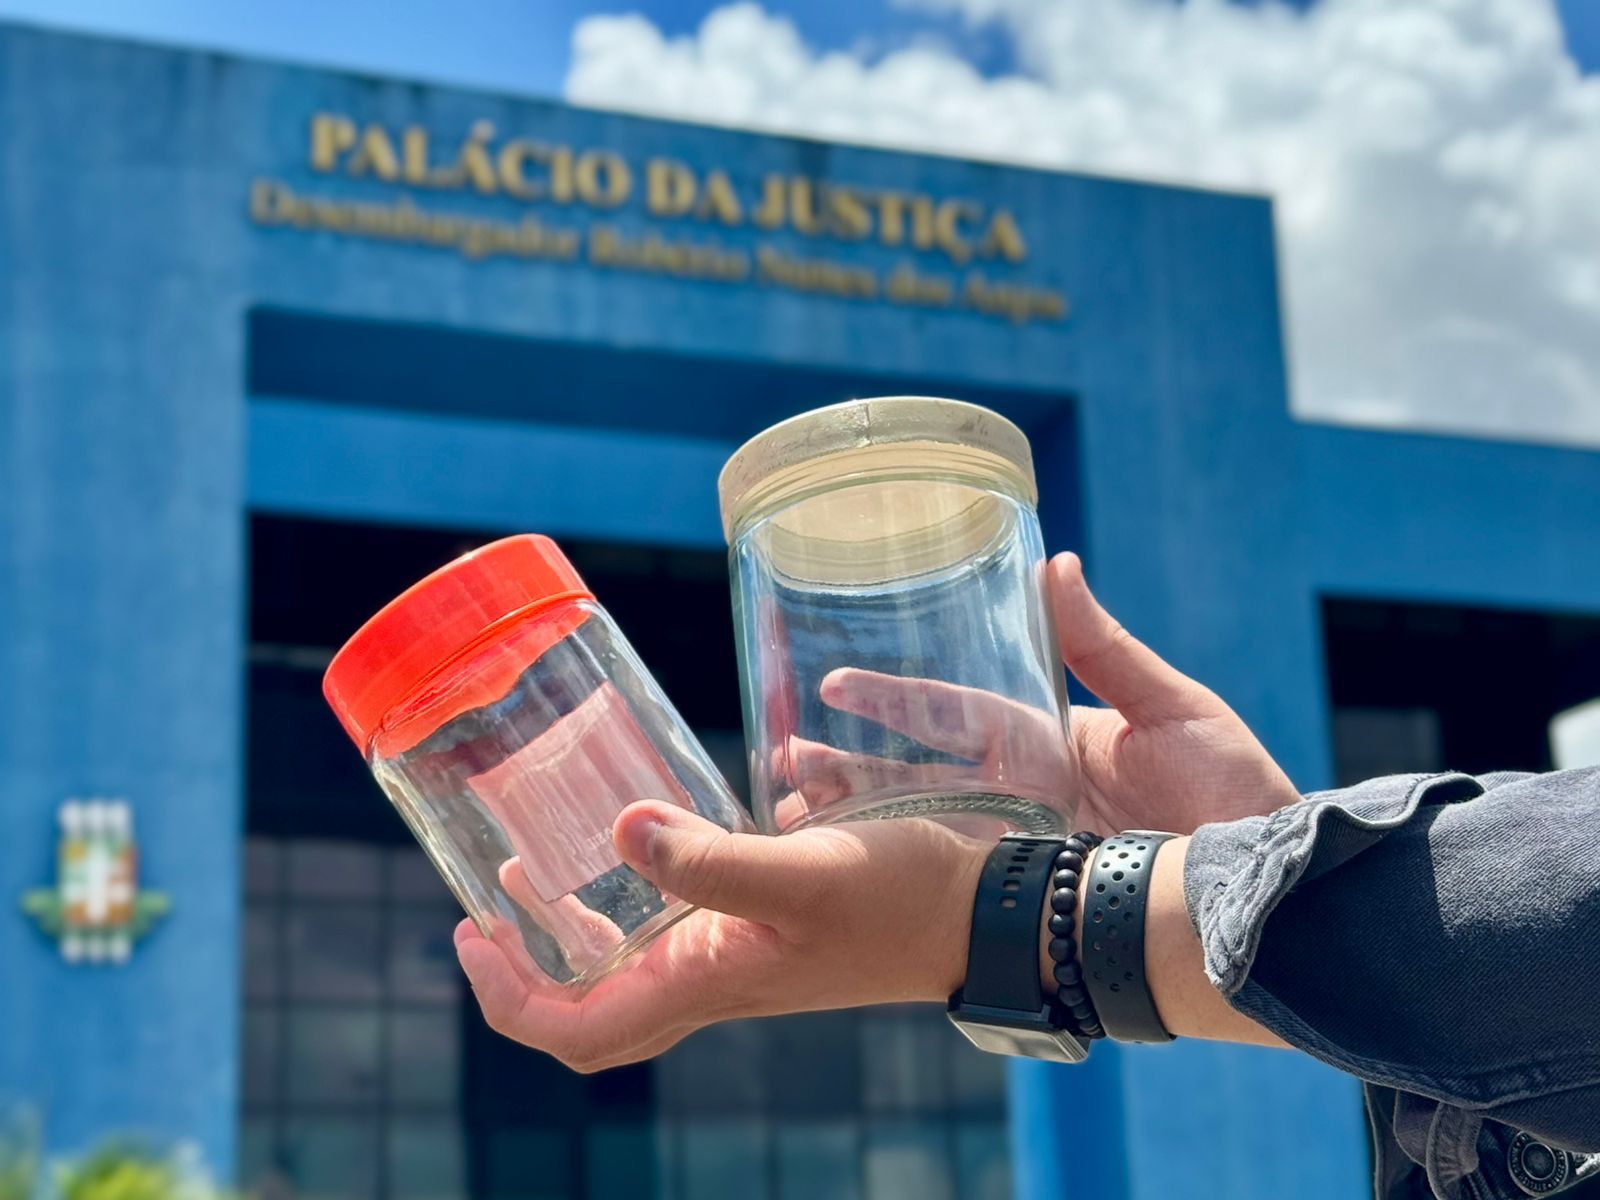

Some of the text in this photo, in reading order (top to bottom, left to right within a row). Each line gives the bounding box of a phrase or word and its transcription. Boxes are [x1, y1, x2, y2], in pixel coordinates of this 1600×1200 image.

[311, 115, 1026, 263] PALÁCIO DA JUSTIÇA
